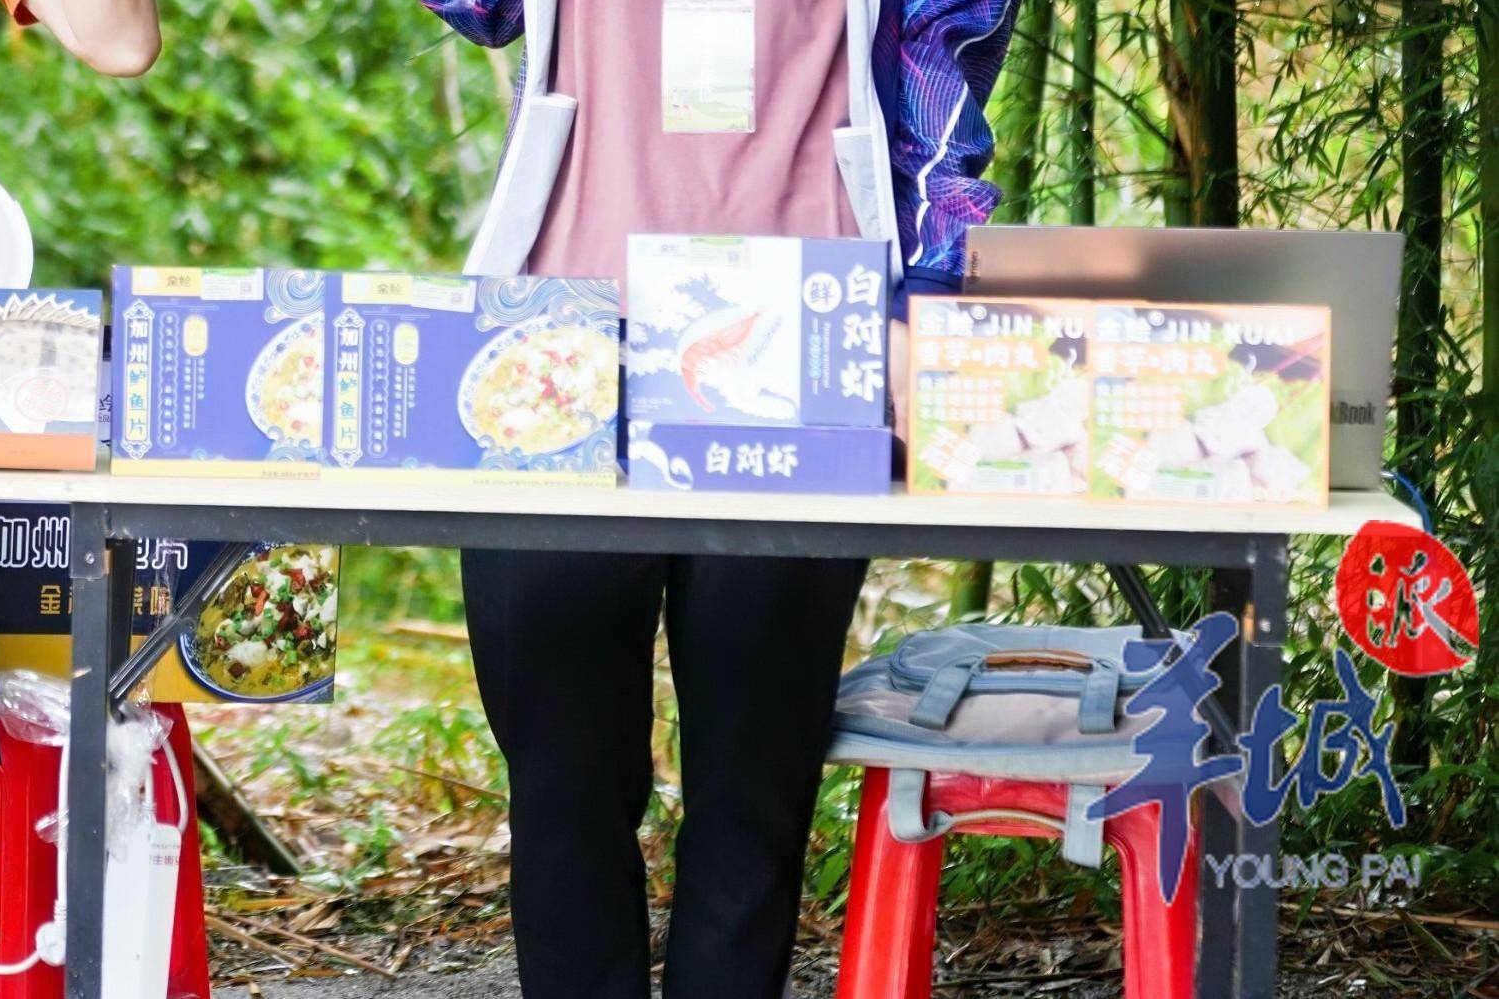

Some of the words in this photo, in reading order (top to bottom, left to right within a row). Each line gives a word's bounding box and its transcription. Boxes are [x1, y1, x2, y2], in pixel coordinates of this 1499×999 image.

[809, 280, 833, 306] 鲜
[839, 263, 885, 403] 白对虾
[985, 313, 1034, 337] JIN
[1167, 319, 1212, 344] JIN
[128, 319, 149, 436] 加州鲈鱼片
[339, 327, 359, 444] 加州鲈鱼片
[705, 441, 799, 478] 白对虾
